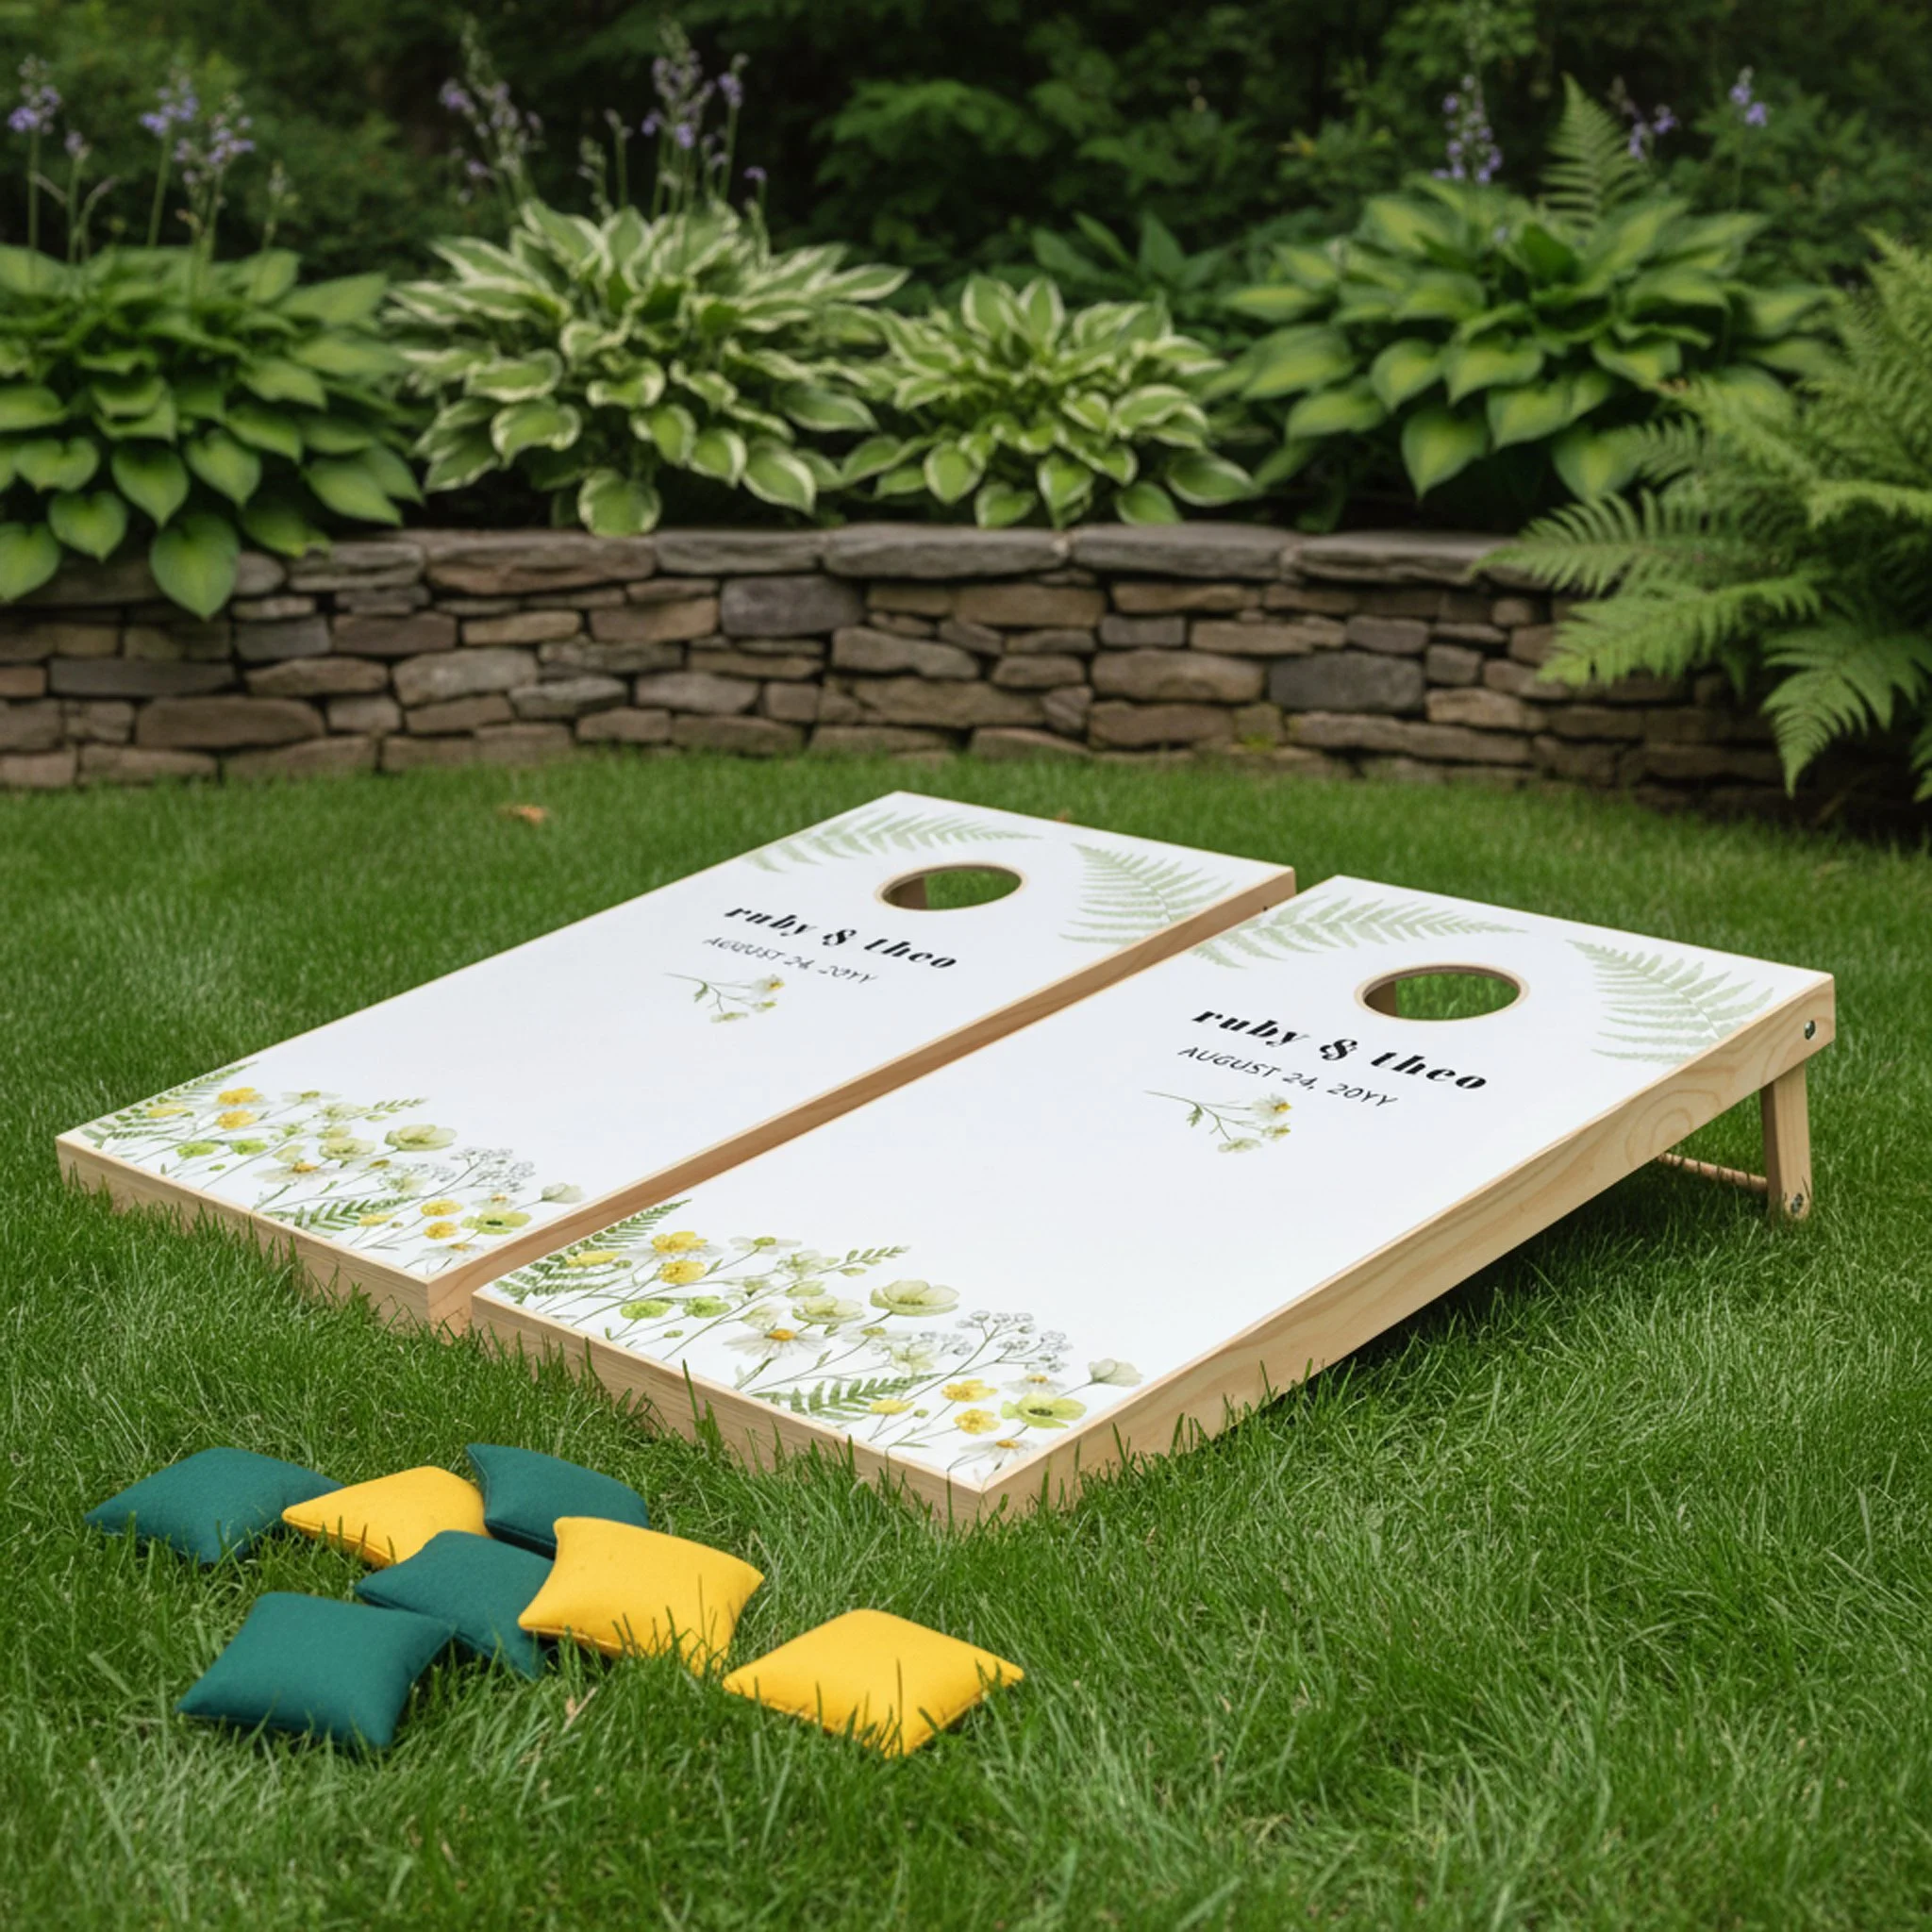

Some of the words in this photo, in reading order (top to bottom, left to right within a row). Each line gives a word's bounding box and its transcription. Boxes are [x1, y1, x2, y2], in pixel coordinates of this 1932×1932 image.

[724, 908, 817, 937] ruby
[822, 928, 858, 948] &
[863, 938, 957, 969] theo
[1177, 1046, 1280, 1078] AUGUST
[1282, 1072, 1319, 1091] 24,
[1326, 1082, 1398, 1108] 20YY
[1191, 1009, 1310, 1047] ruby
[1319, 1038, 1358, 1062] &
[1371, 1051, 1488, 1091] theo
